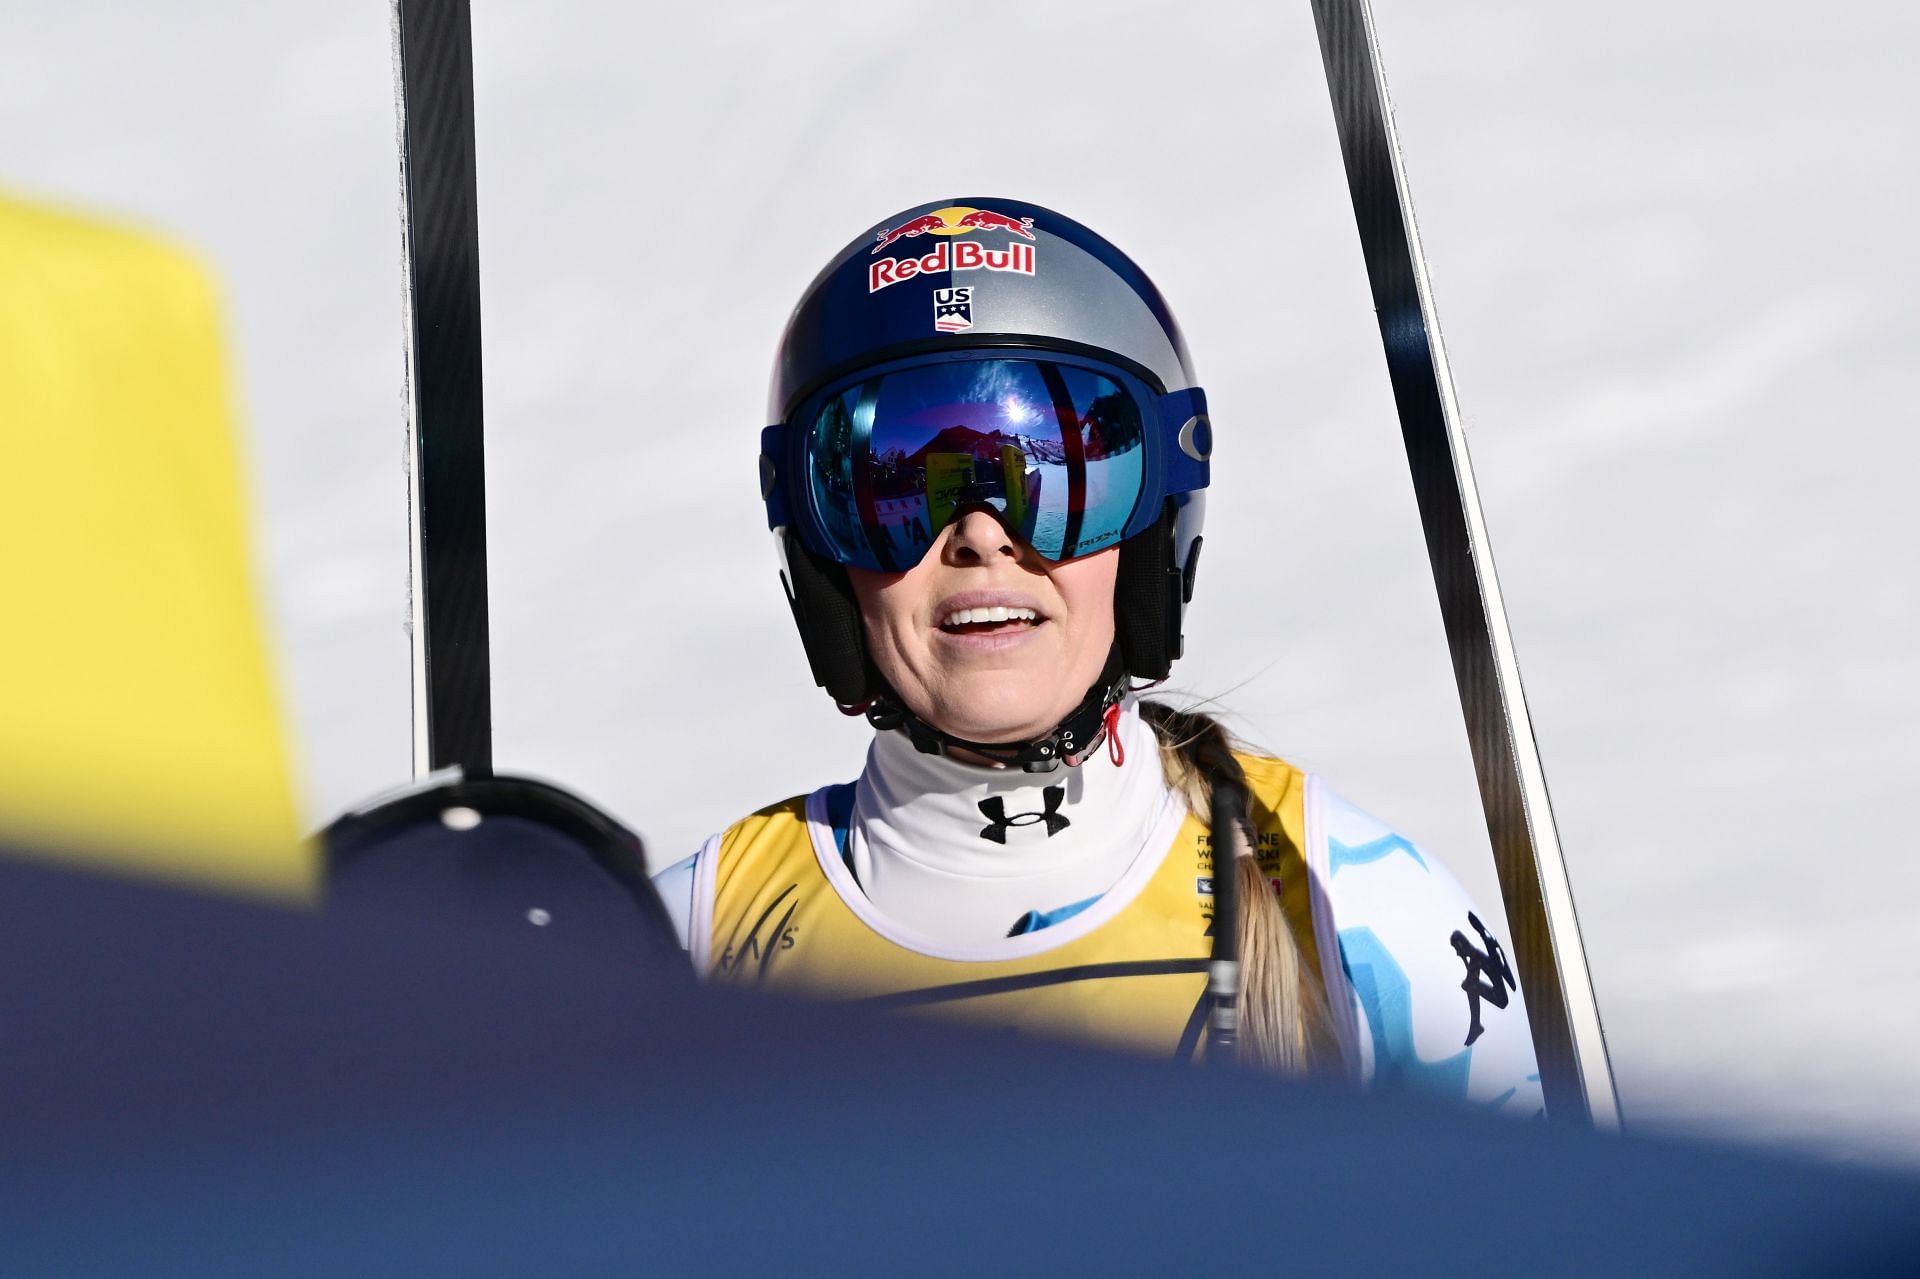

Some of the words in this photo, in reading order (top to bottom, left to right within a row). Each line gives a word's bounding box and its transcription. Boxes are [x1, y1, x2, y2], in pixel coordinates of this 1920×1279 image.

[870, 241, 949, 293] Red
[953, 241, 1036, 276] Bull
[935, 288, 970, 304] US
[1067, 529, 1118, 551] RIZM
